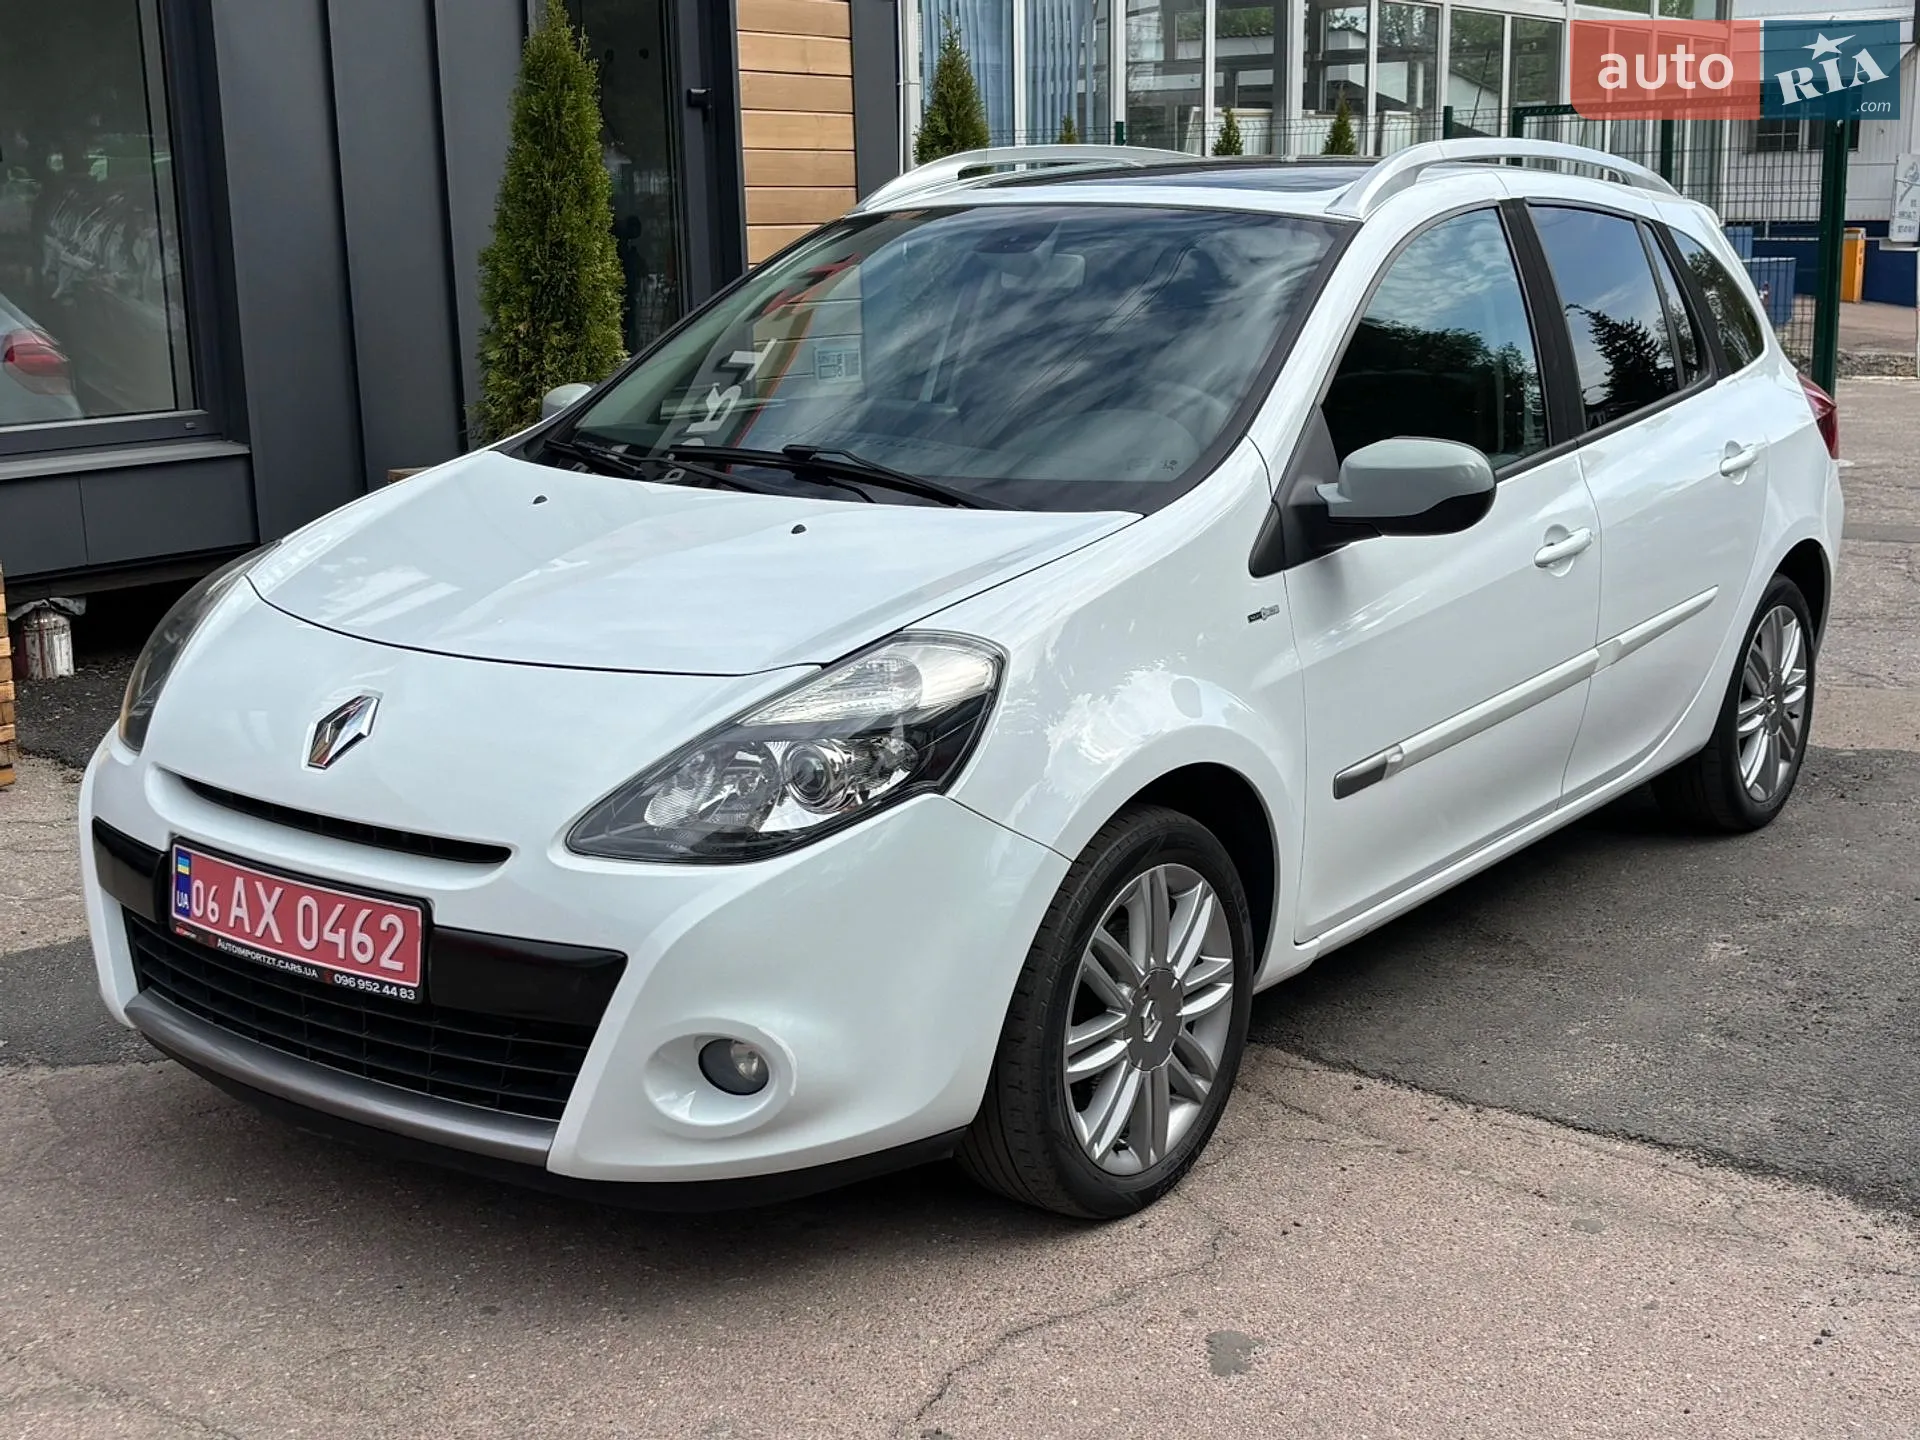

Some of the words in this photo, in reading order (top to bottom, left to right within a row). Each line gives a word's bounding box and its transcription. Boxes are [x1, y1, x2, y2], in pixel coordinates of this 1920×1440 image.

[177, 890, 189, 910] UA
[193, 880, 219, 923] 06
[228, 876, 284, 944] AX
[297, 895, 405, 971] 0462
[334, 973, 356, 987] 096
[357, 979, 380, 993] 952
[382, 985, 398, 996] 44
[399, 988, 415, 1000] 83
